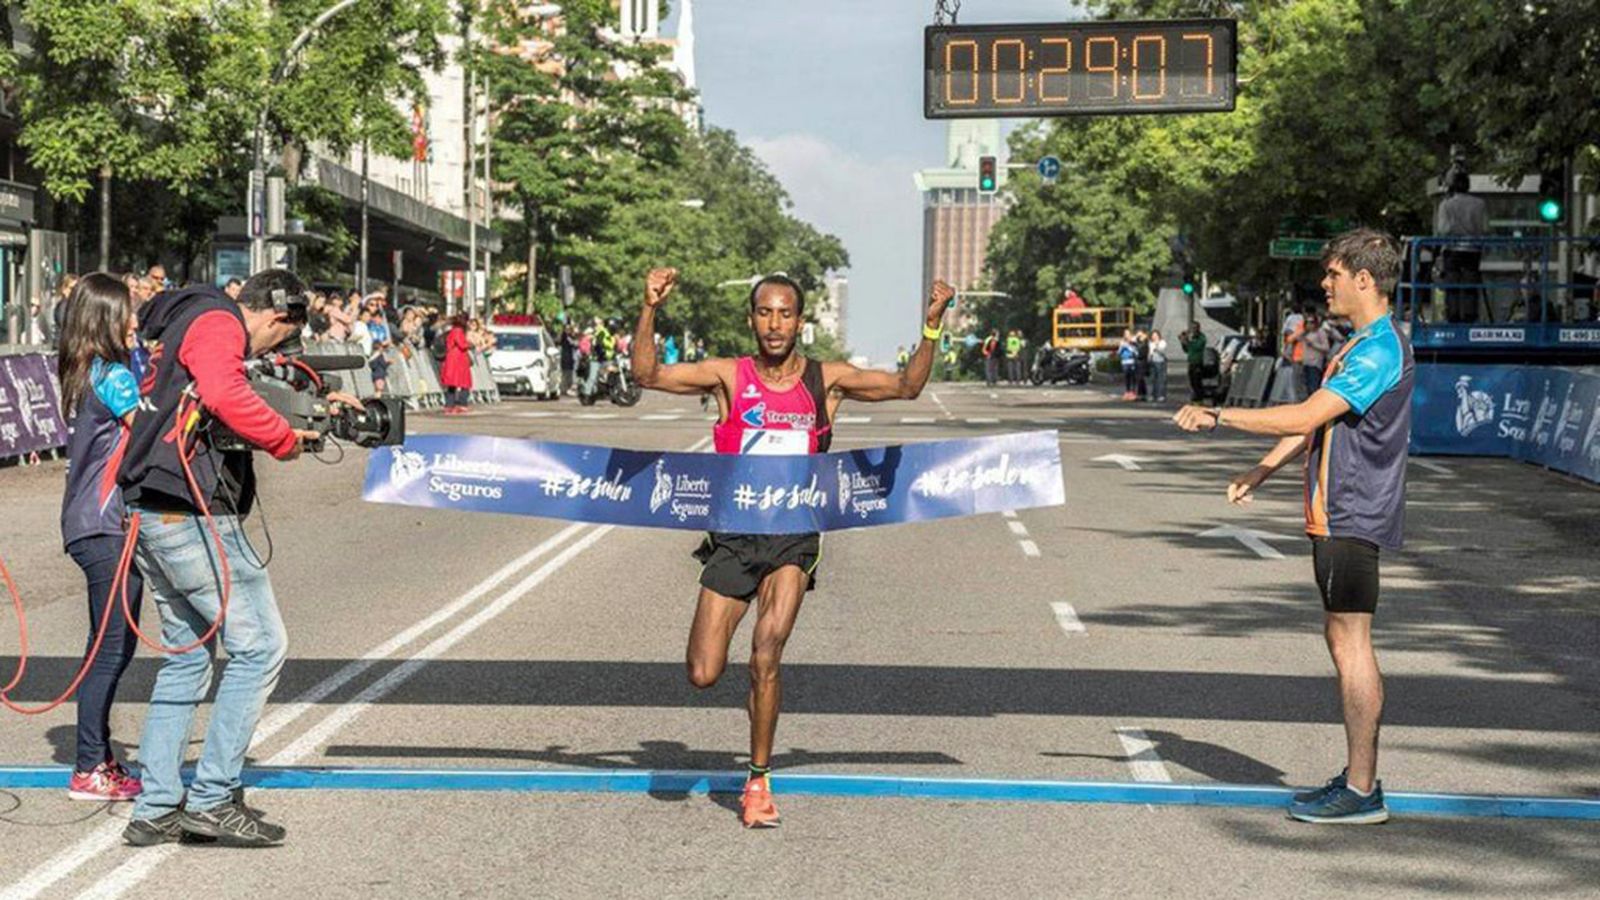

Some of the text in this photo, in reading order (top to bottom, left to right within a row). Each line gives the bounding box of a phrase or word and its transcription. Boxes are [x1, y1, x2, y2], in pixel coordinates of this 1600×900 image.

[946, 34, 1213, 104] 00:29:07
[432, 454, 504, 478] Liberty
[429, 477, 502, 501] Seguros
[675, 474, 711, 494] Liberty
[669, 499, 710, 522] Seguros
[852, 496, 887, 519] Seguros
